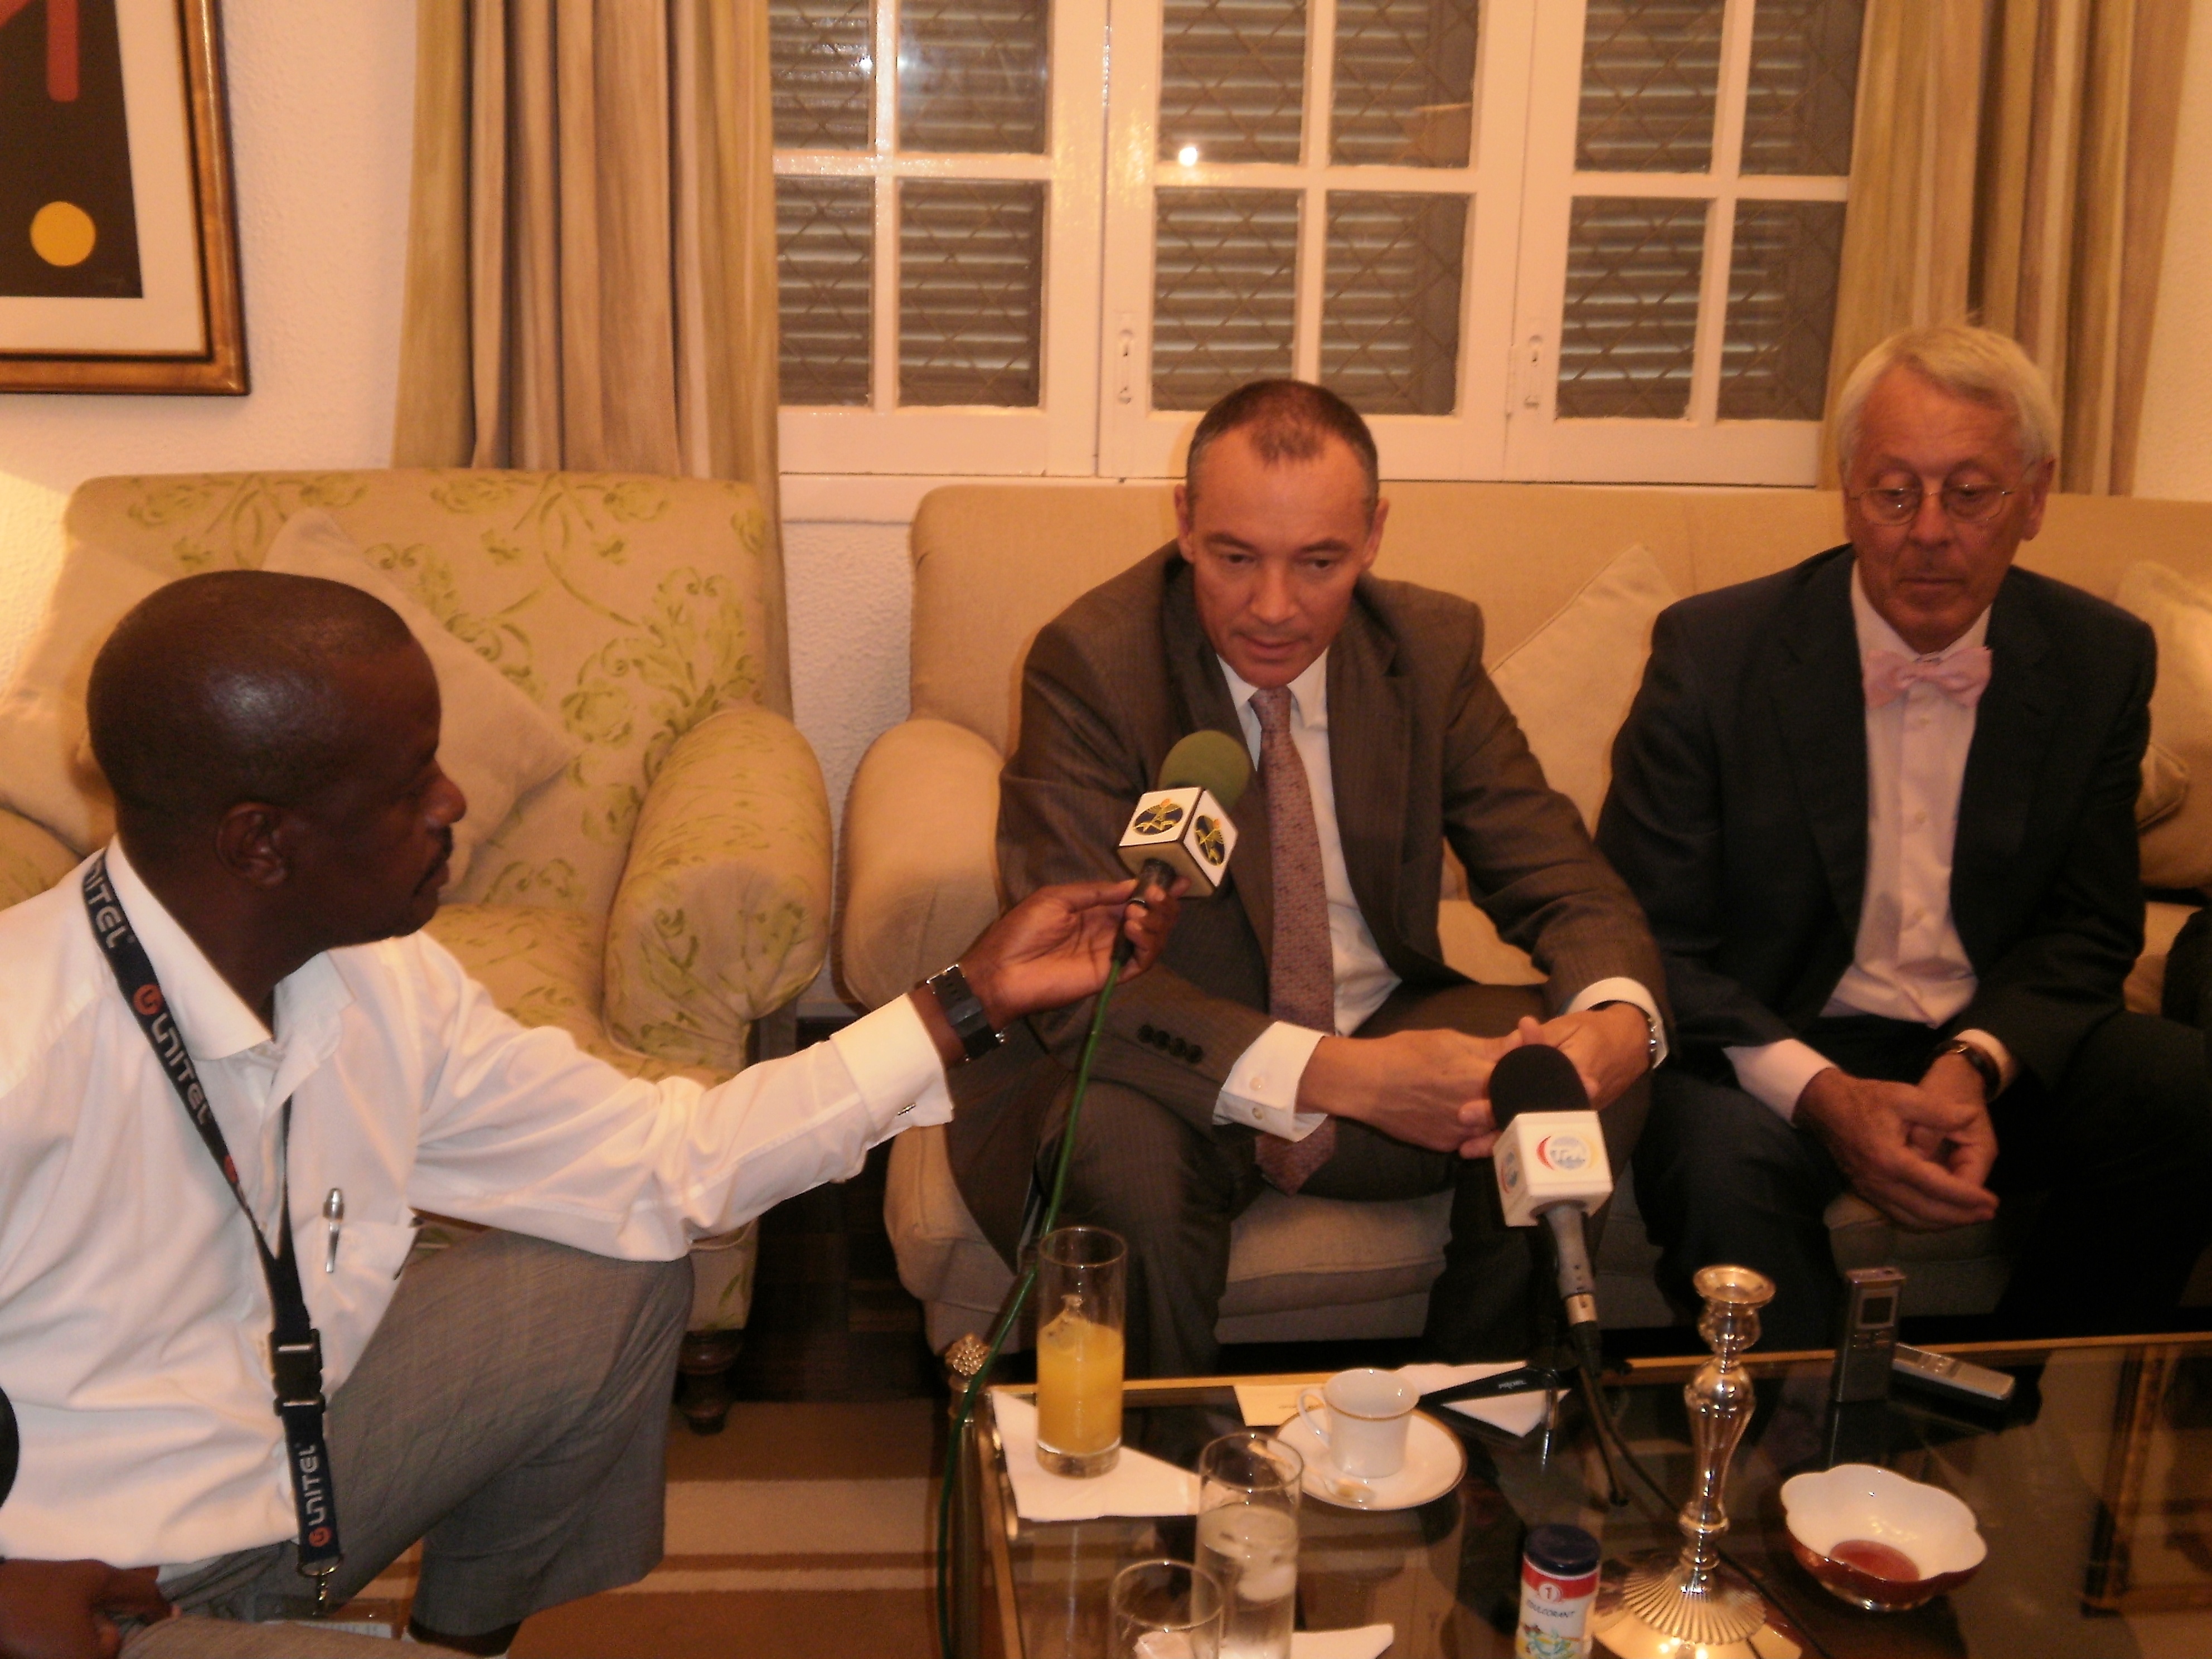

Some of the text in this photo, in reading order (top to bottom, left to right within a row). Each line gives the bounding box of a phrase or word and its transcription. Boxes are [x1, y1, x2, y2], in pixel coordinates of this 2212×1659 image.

[85, 858, 128, 949] NITEL
[152, 1013, 210, 1125] UNITEL
[299, 1444, 326, 1526] UNITEL
